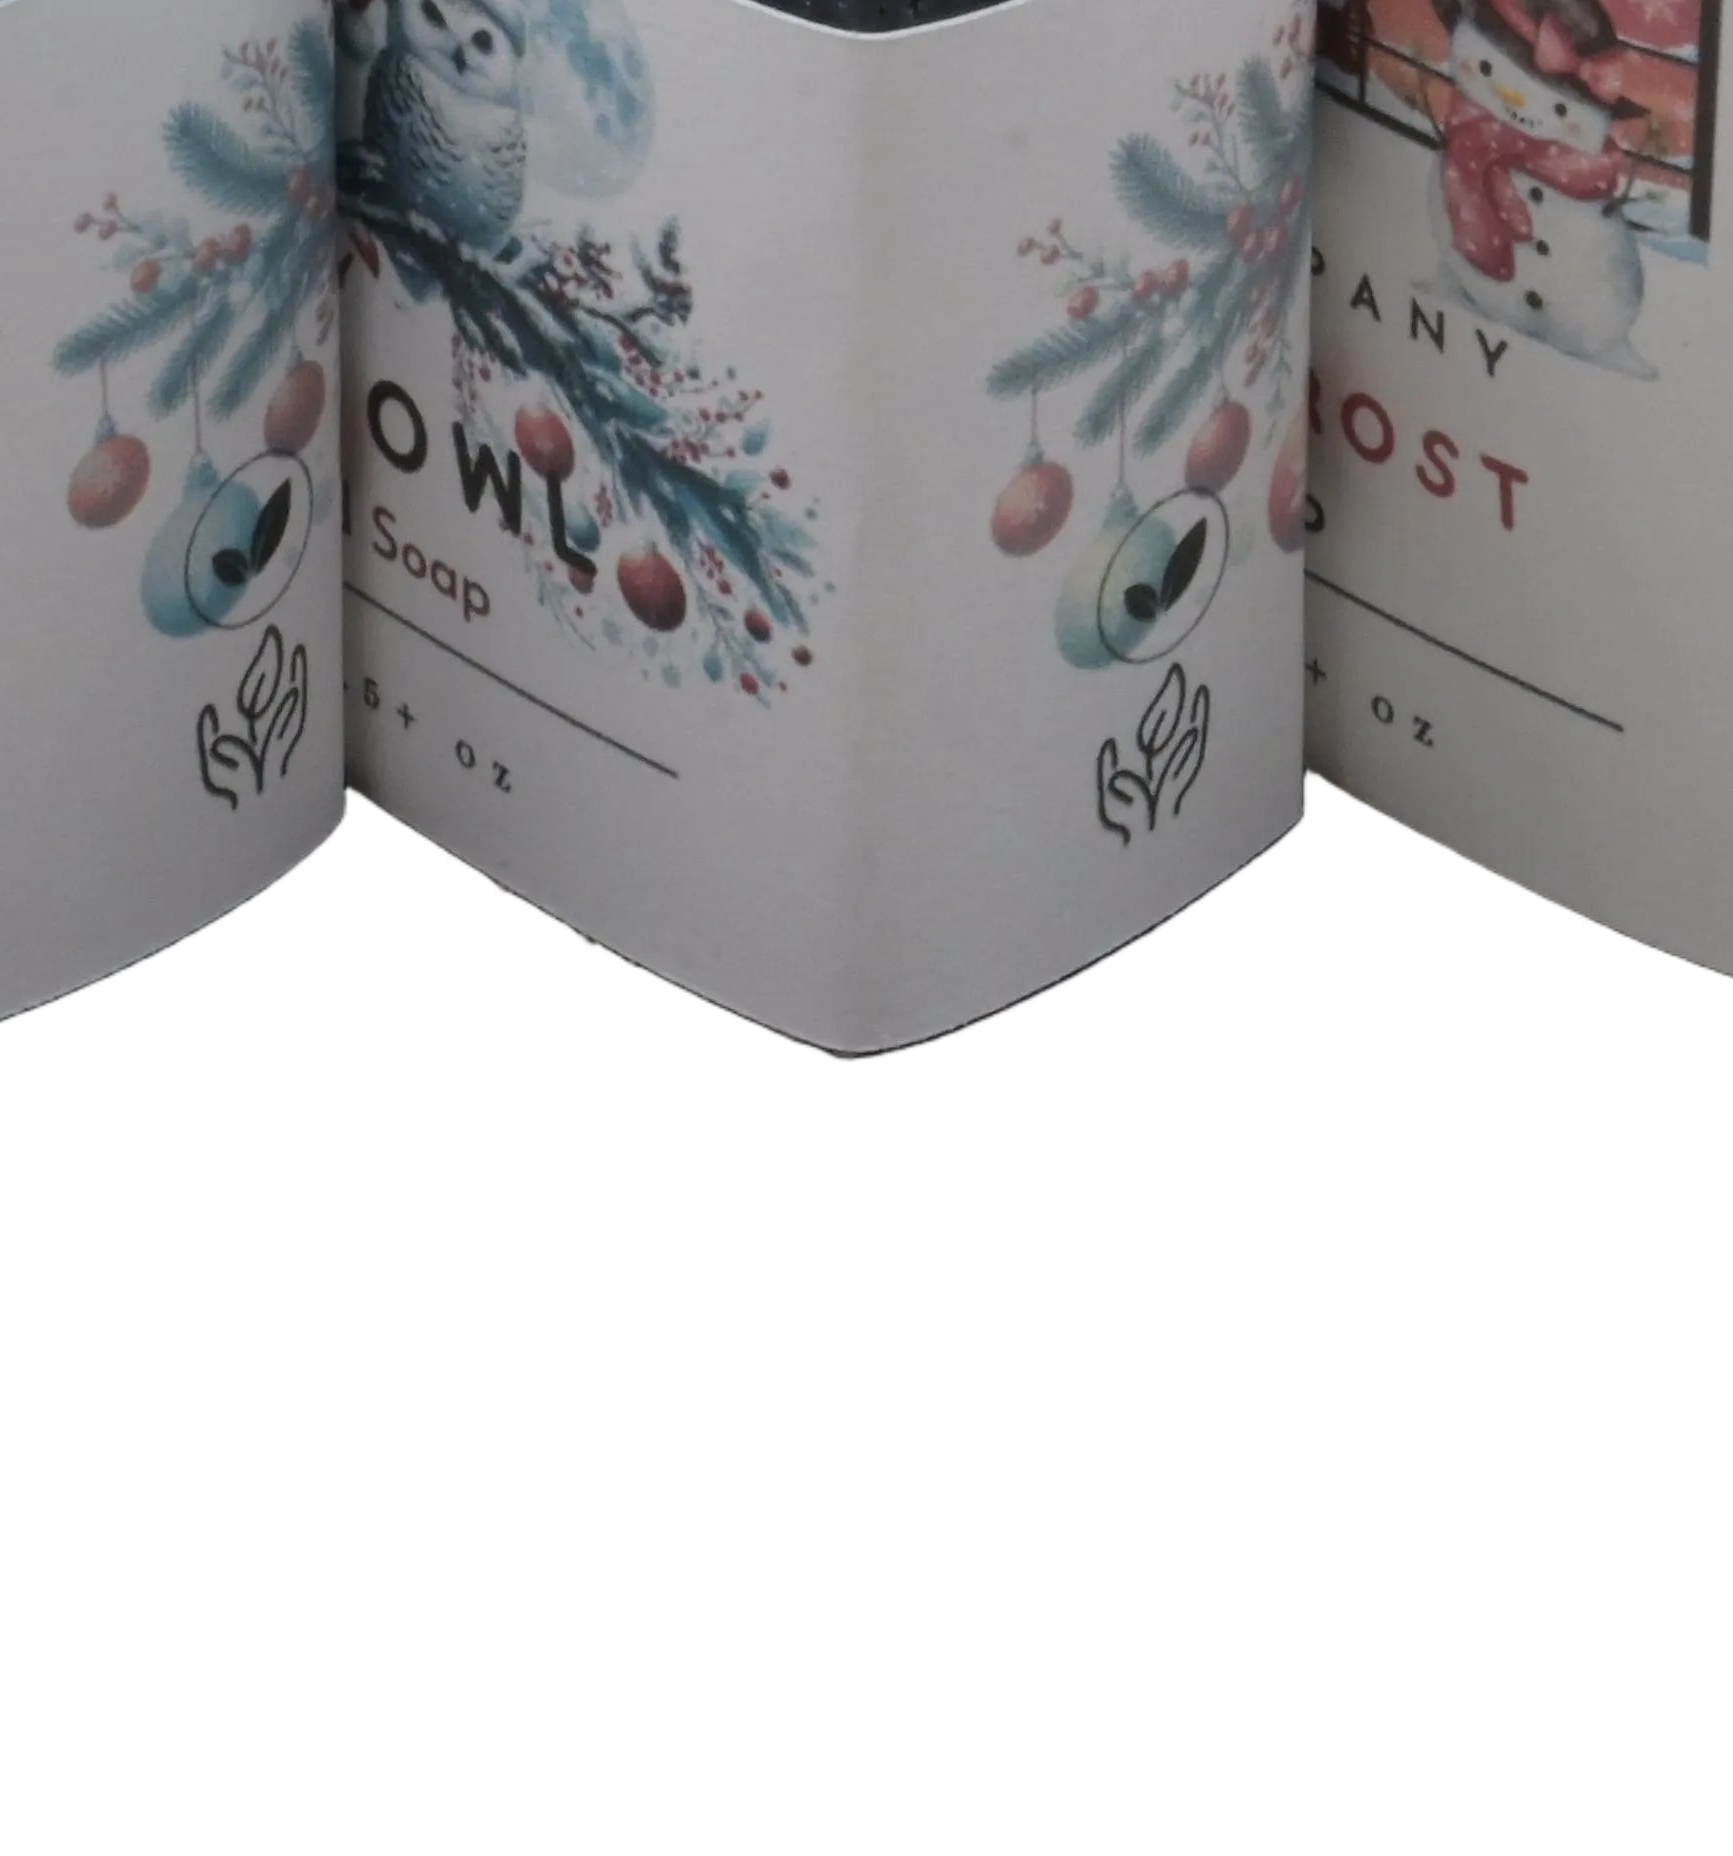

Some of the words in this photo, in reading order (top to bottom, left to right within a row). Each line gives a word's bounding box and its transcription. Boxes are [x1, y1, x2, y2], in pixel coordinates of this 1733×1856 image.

[368, 379, 599, 578] OWL
[371, 505, 492, 623] Soap
[1370, 694, 1436, 749] oz
[454, 738, 513, 794] oz
